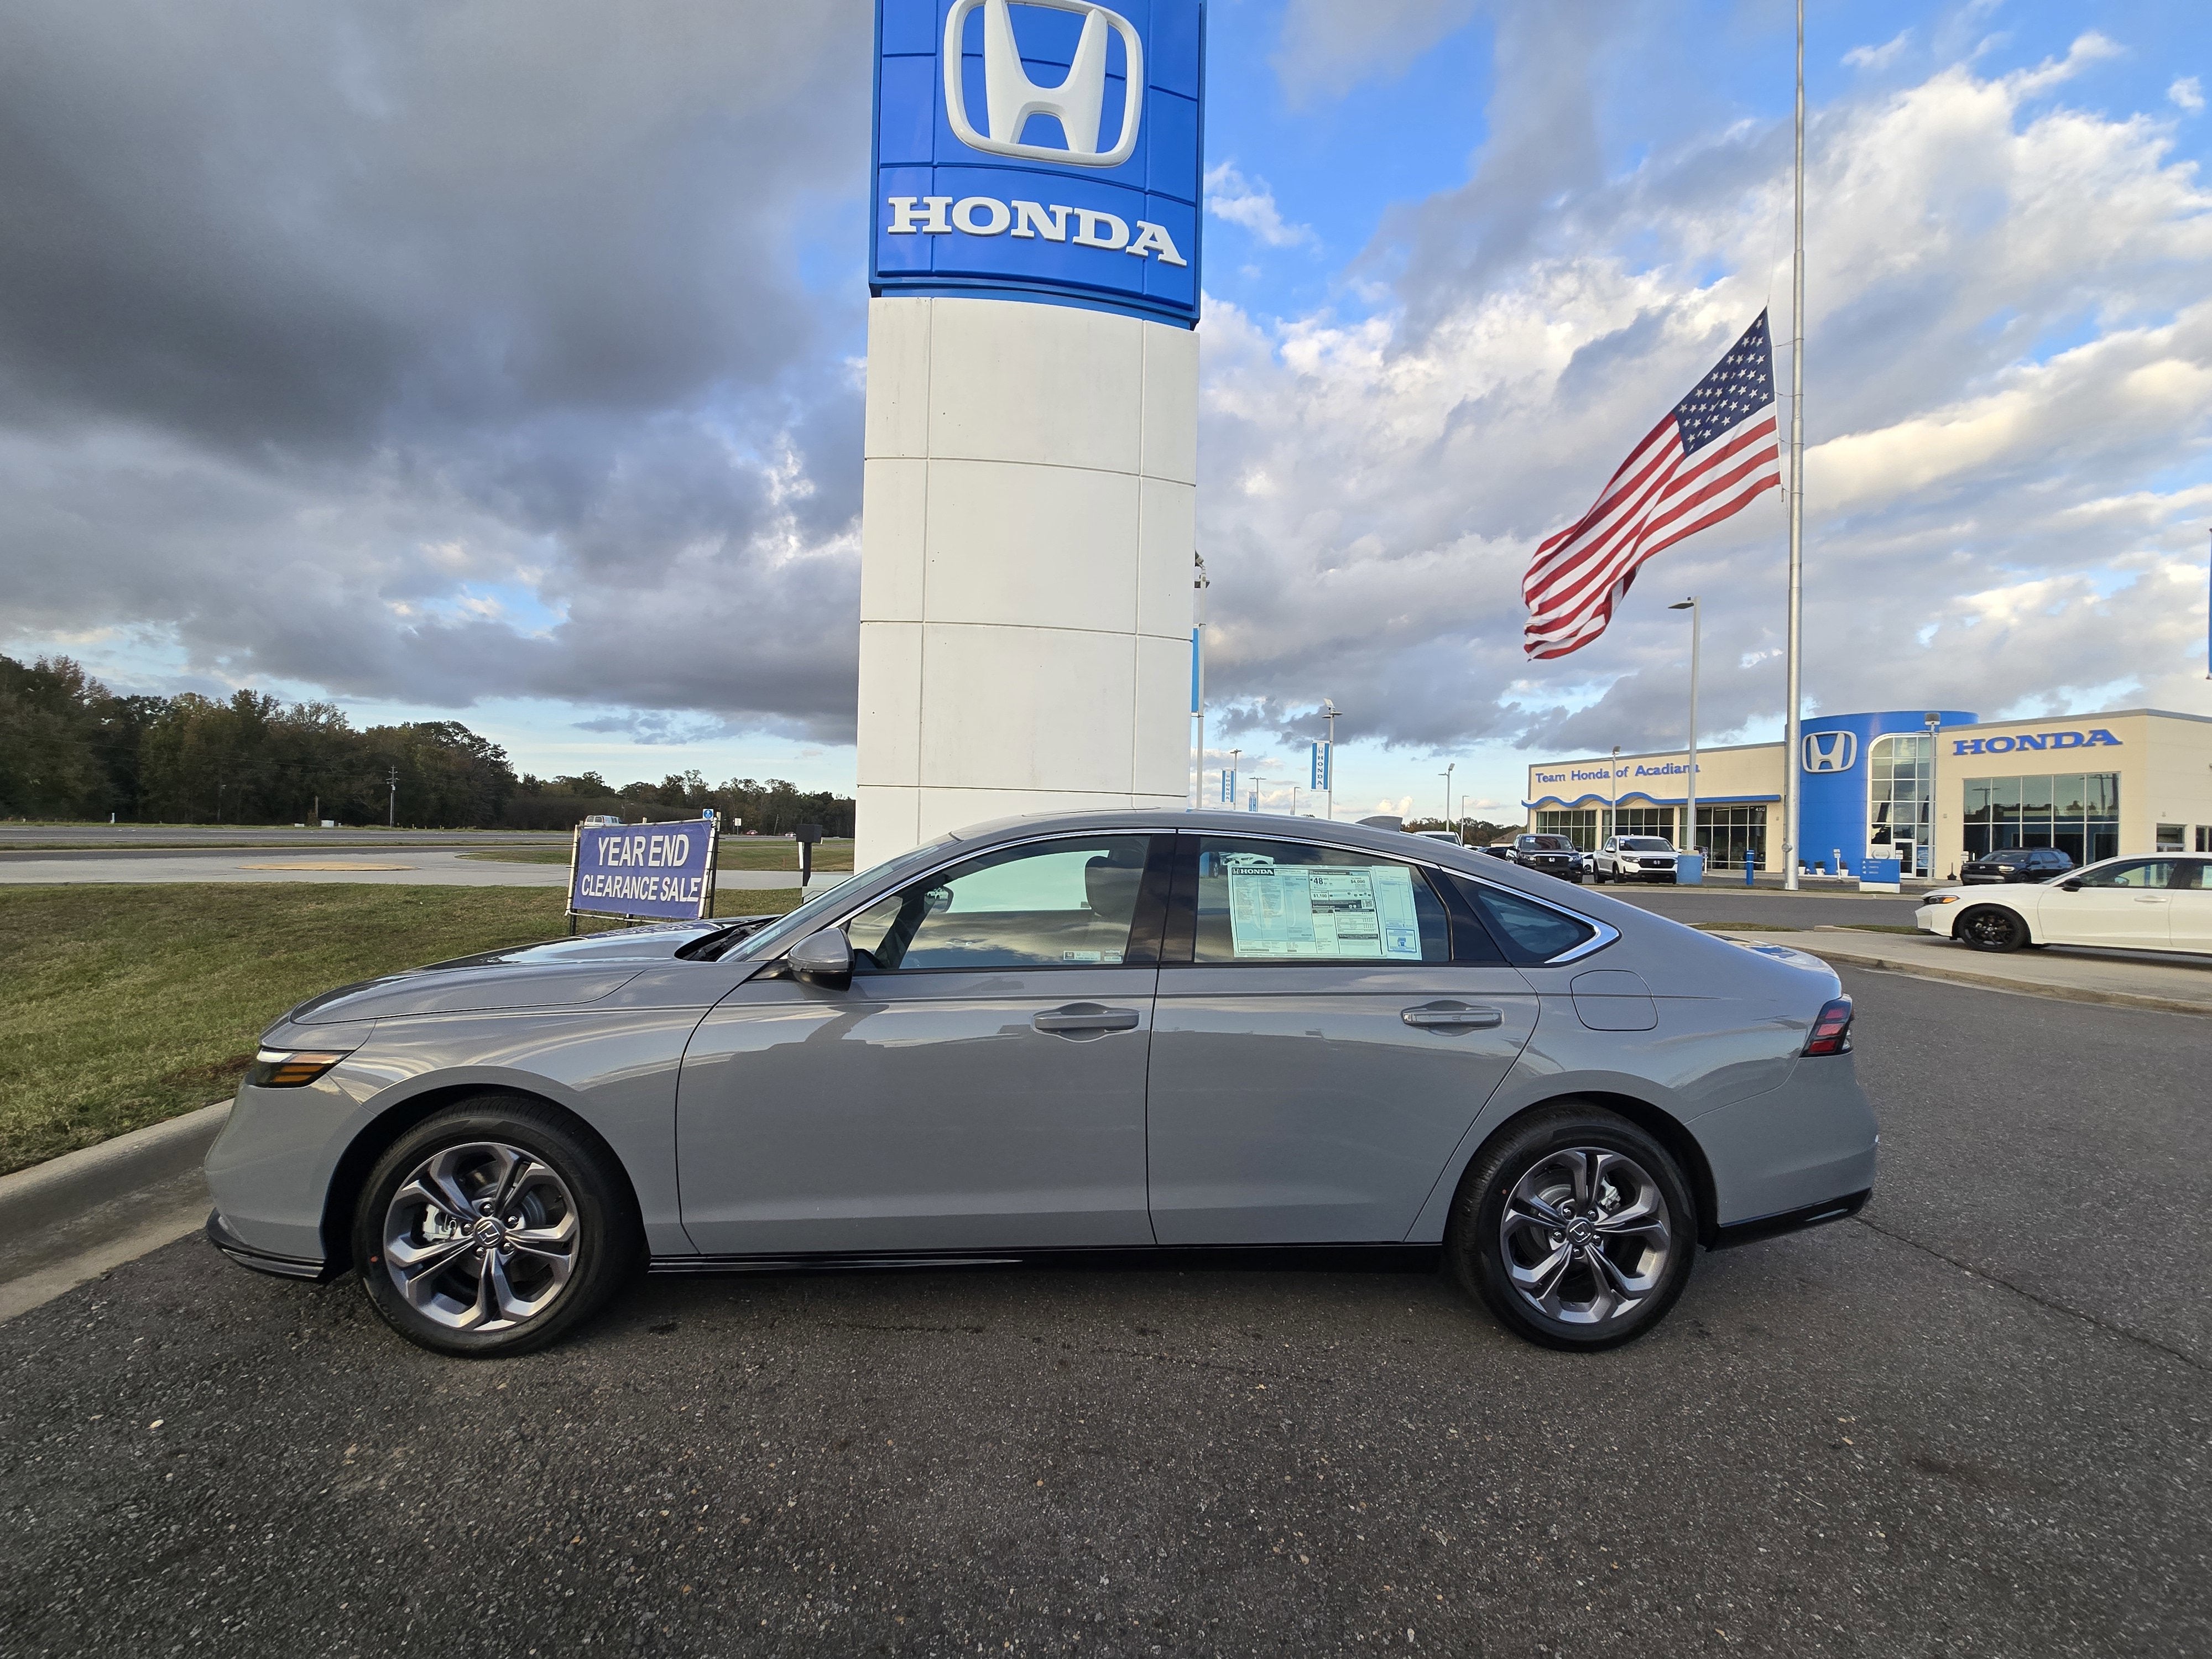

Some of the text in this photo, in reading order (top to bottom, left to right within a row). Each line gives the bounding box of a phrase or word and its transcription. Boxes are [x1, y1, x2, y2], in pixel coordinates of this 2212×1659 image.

[888, 196, 1187, 267] HONDA
[1953, 729, 2123, 755] HONDA
[1536, 763, 1700, 782] Team Honda of Acadiana
[598, 834, 690, 867] YEAR END
[582, 874, 701, 902] CLEARANCE SALE
